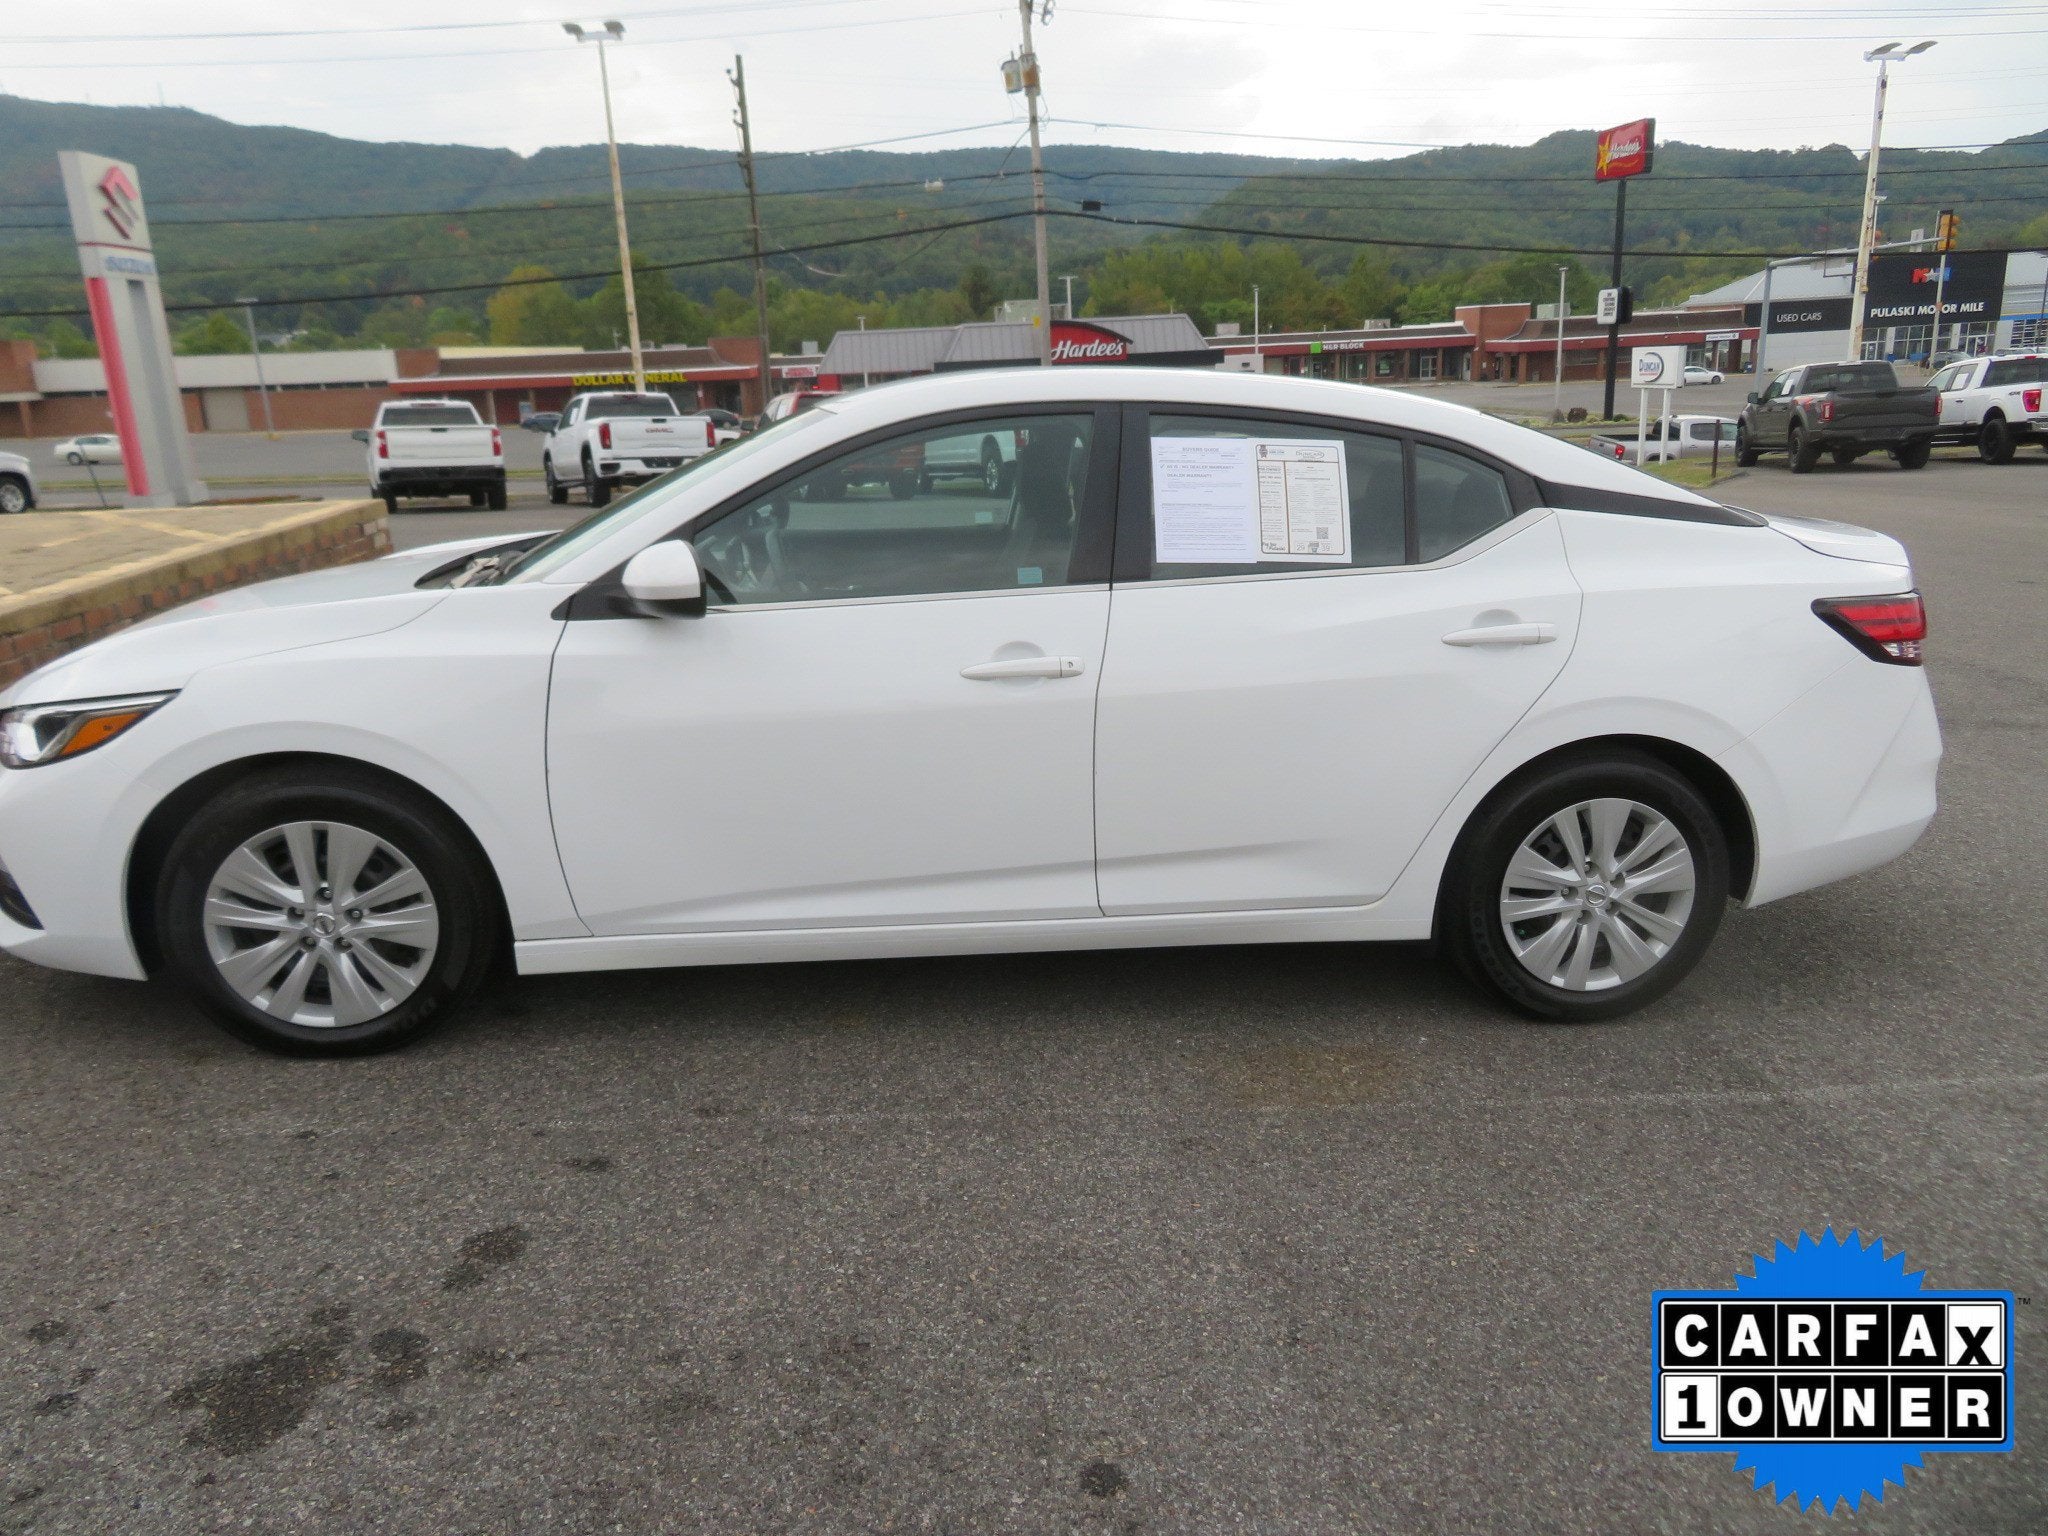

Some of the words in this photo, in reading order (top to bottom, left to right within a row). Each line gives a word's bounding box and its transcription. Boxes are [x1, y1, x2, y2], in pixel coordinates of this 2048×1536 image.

[1777, 313, 1798, 322] USED
[1801, 312, 1822, 321] CARS
[1870, 306, 1915, 318] PULASKI
[1917, 303, 1957, 315] MOOR
[1960, 302, 1985, 312] MILE
[1051, 339, 1123, 360] Hardee's
[1340, 342, 1364, 350] BLOCK
[573, 375, 624, 386] DOLLAR
[627, 371, 687, 383] GNERAL
